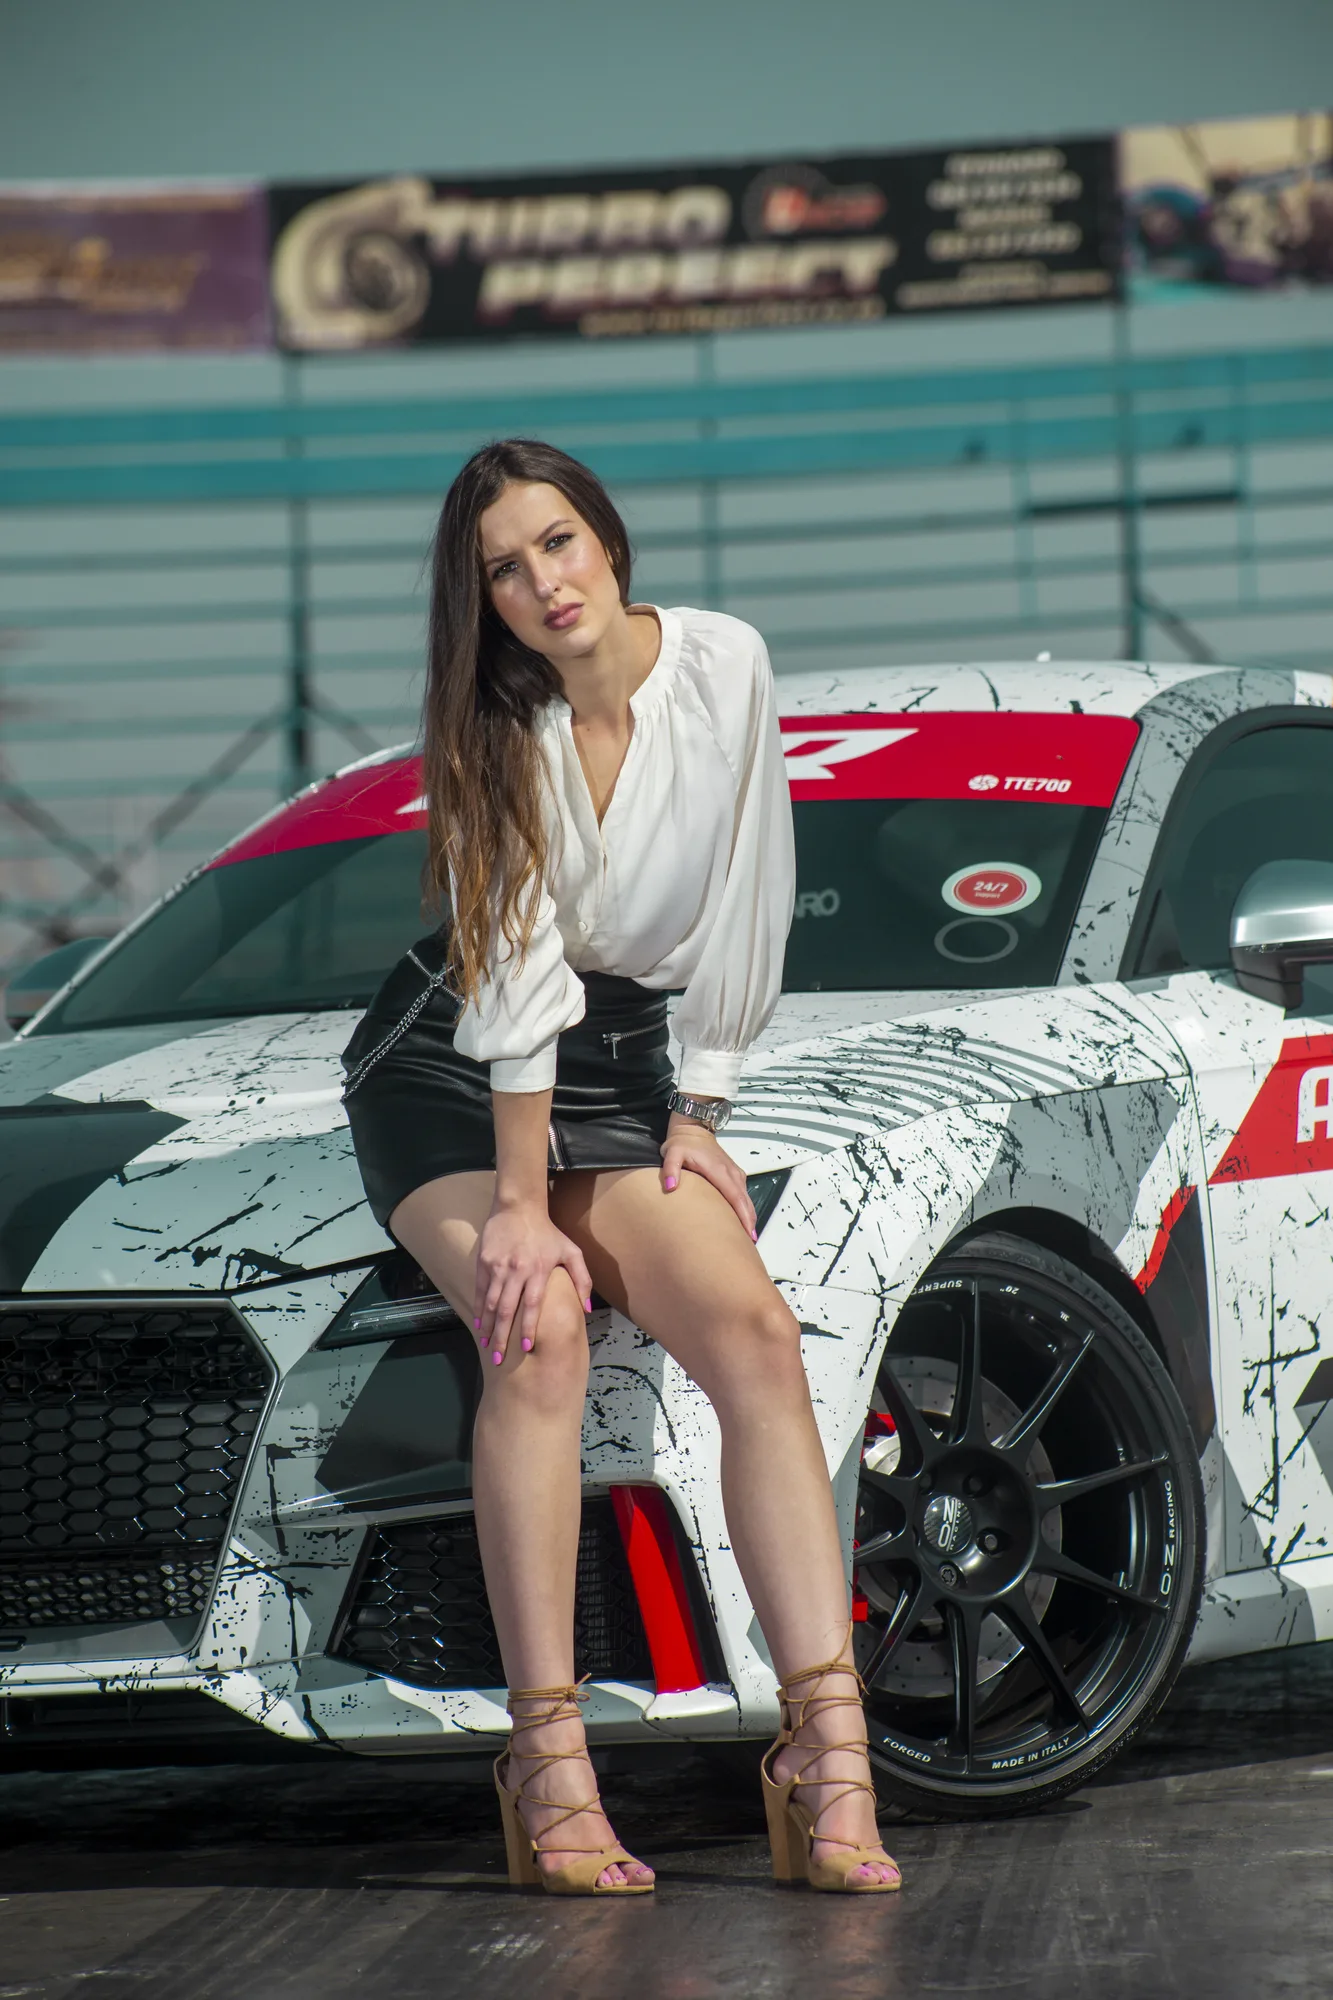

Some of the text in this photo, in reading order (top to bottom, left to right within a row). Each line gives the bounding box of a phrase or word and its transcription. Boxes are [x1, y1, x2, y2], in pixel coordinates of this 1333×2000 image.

[1003, 776, 1072, 793] TTE700
[973, 881, 1009, 893] 24/7
[1164, 1480, 1176, 1539] RACING
[883, 1736, 932, 1763] FORGED
[991, 1737, 1070, 1770] MADE IN ITALY
